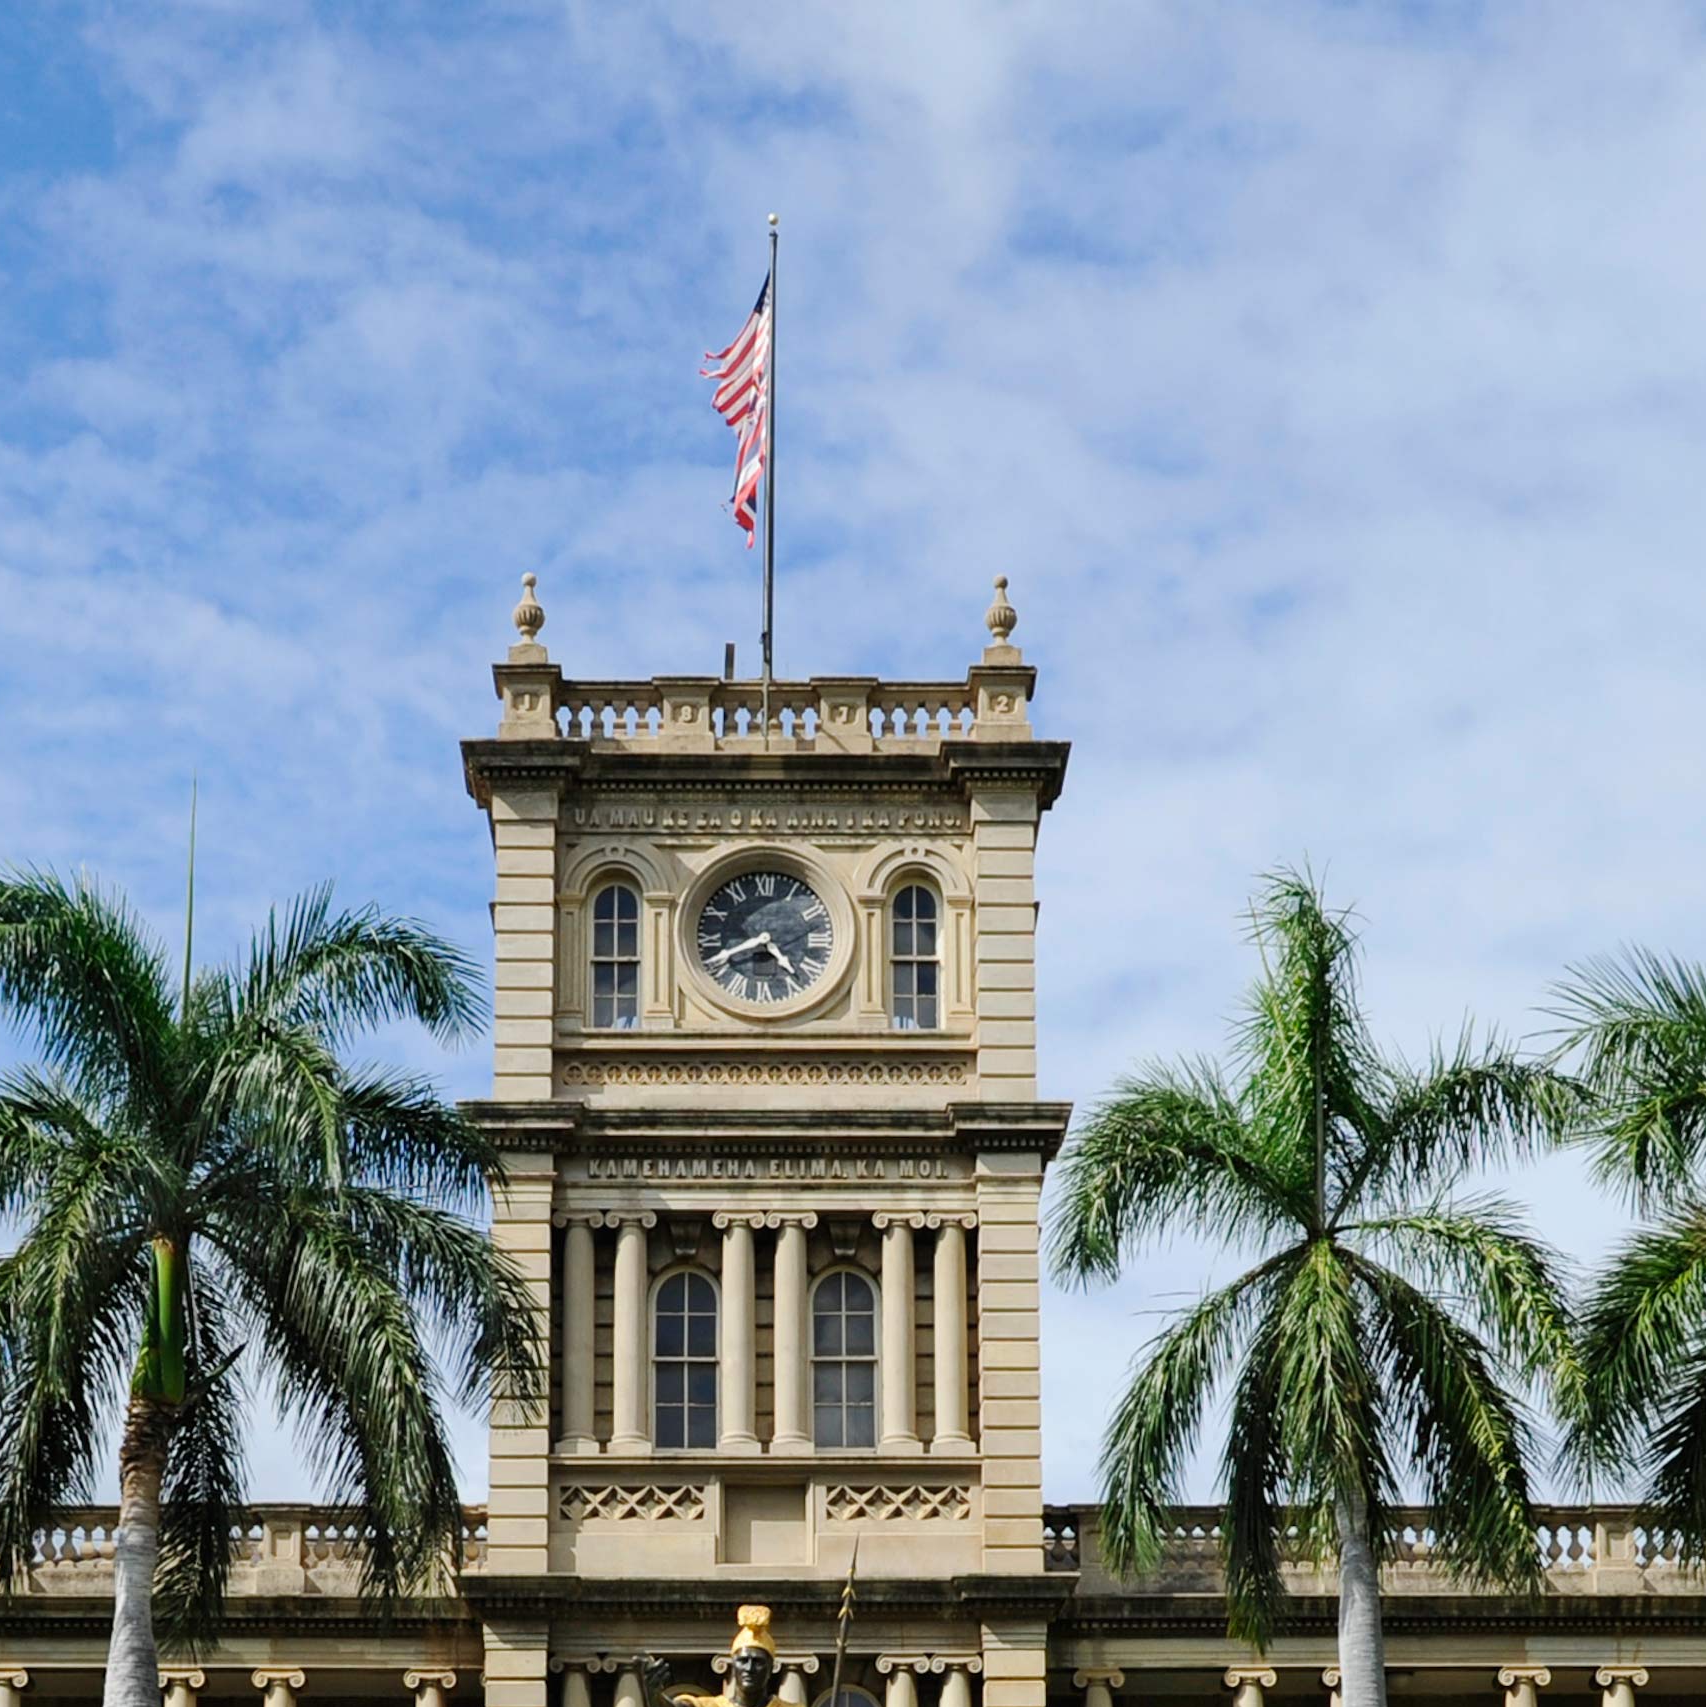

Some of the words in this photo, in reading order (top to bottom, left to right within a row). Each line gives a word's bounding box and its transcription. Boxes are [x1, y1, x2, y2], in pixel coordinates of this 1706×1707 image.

[680, 705, 692, 721] 8
[996, 695, 1009, 711] 2
[574, 807, 600, 827] UA
[609, 807, 654, 827] MAU
[661, 807, 688, 827] KE
[696, 807, 721, 827] EA
[730, 808, 742, 827] O
[750, 808, 777, 827] KA
[787, 808, 838, 827] AINA
[861, 809, 890, 827] KA
[723, 881, 747, 906] XI
[754, 873, 775, 897] XII
[702, 905, 728, 921] X
[801, 899, 825, 921] II
[807, 931, 832, 948] III
[589, 1158, 757, 1177] KAMEHAMEHA
[856, 1159, 886, 1177] KA
[899, 1159, 948, 1178] MOI.
